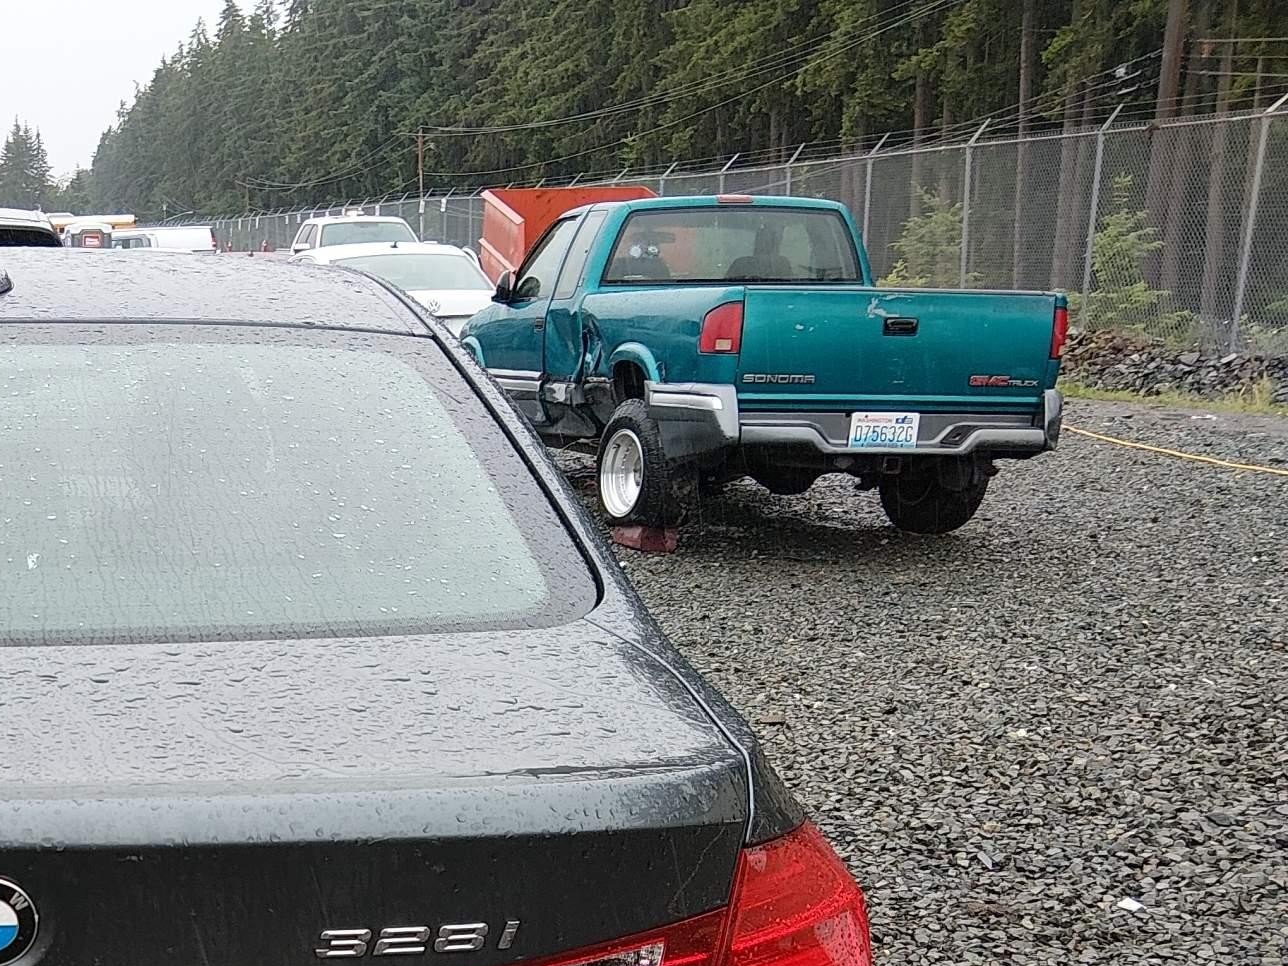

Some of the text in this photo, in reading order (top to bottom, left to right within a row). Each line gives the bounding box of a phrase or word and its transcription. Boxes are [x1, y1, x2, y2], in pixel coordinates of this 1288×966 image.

[742, 373, 816, 384] SONOMA
[969, 375, 1010, 386] GMC
[854, 425, 914, 442] D75632G
[315, 920, 520, 959] 328i
